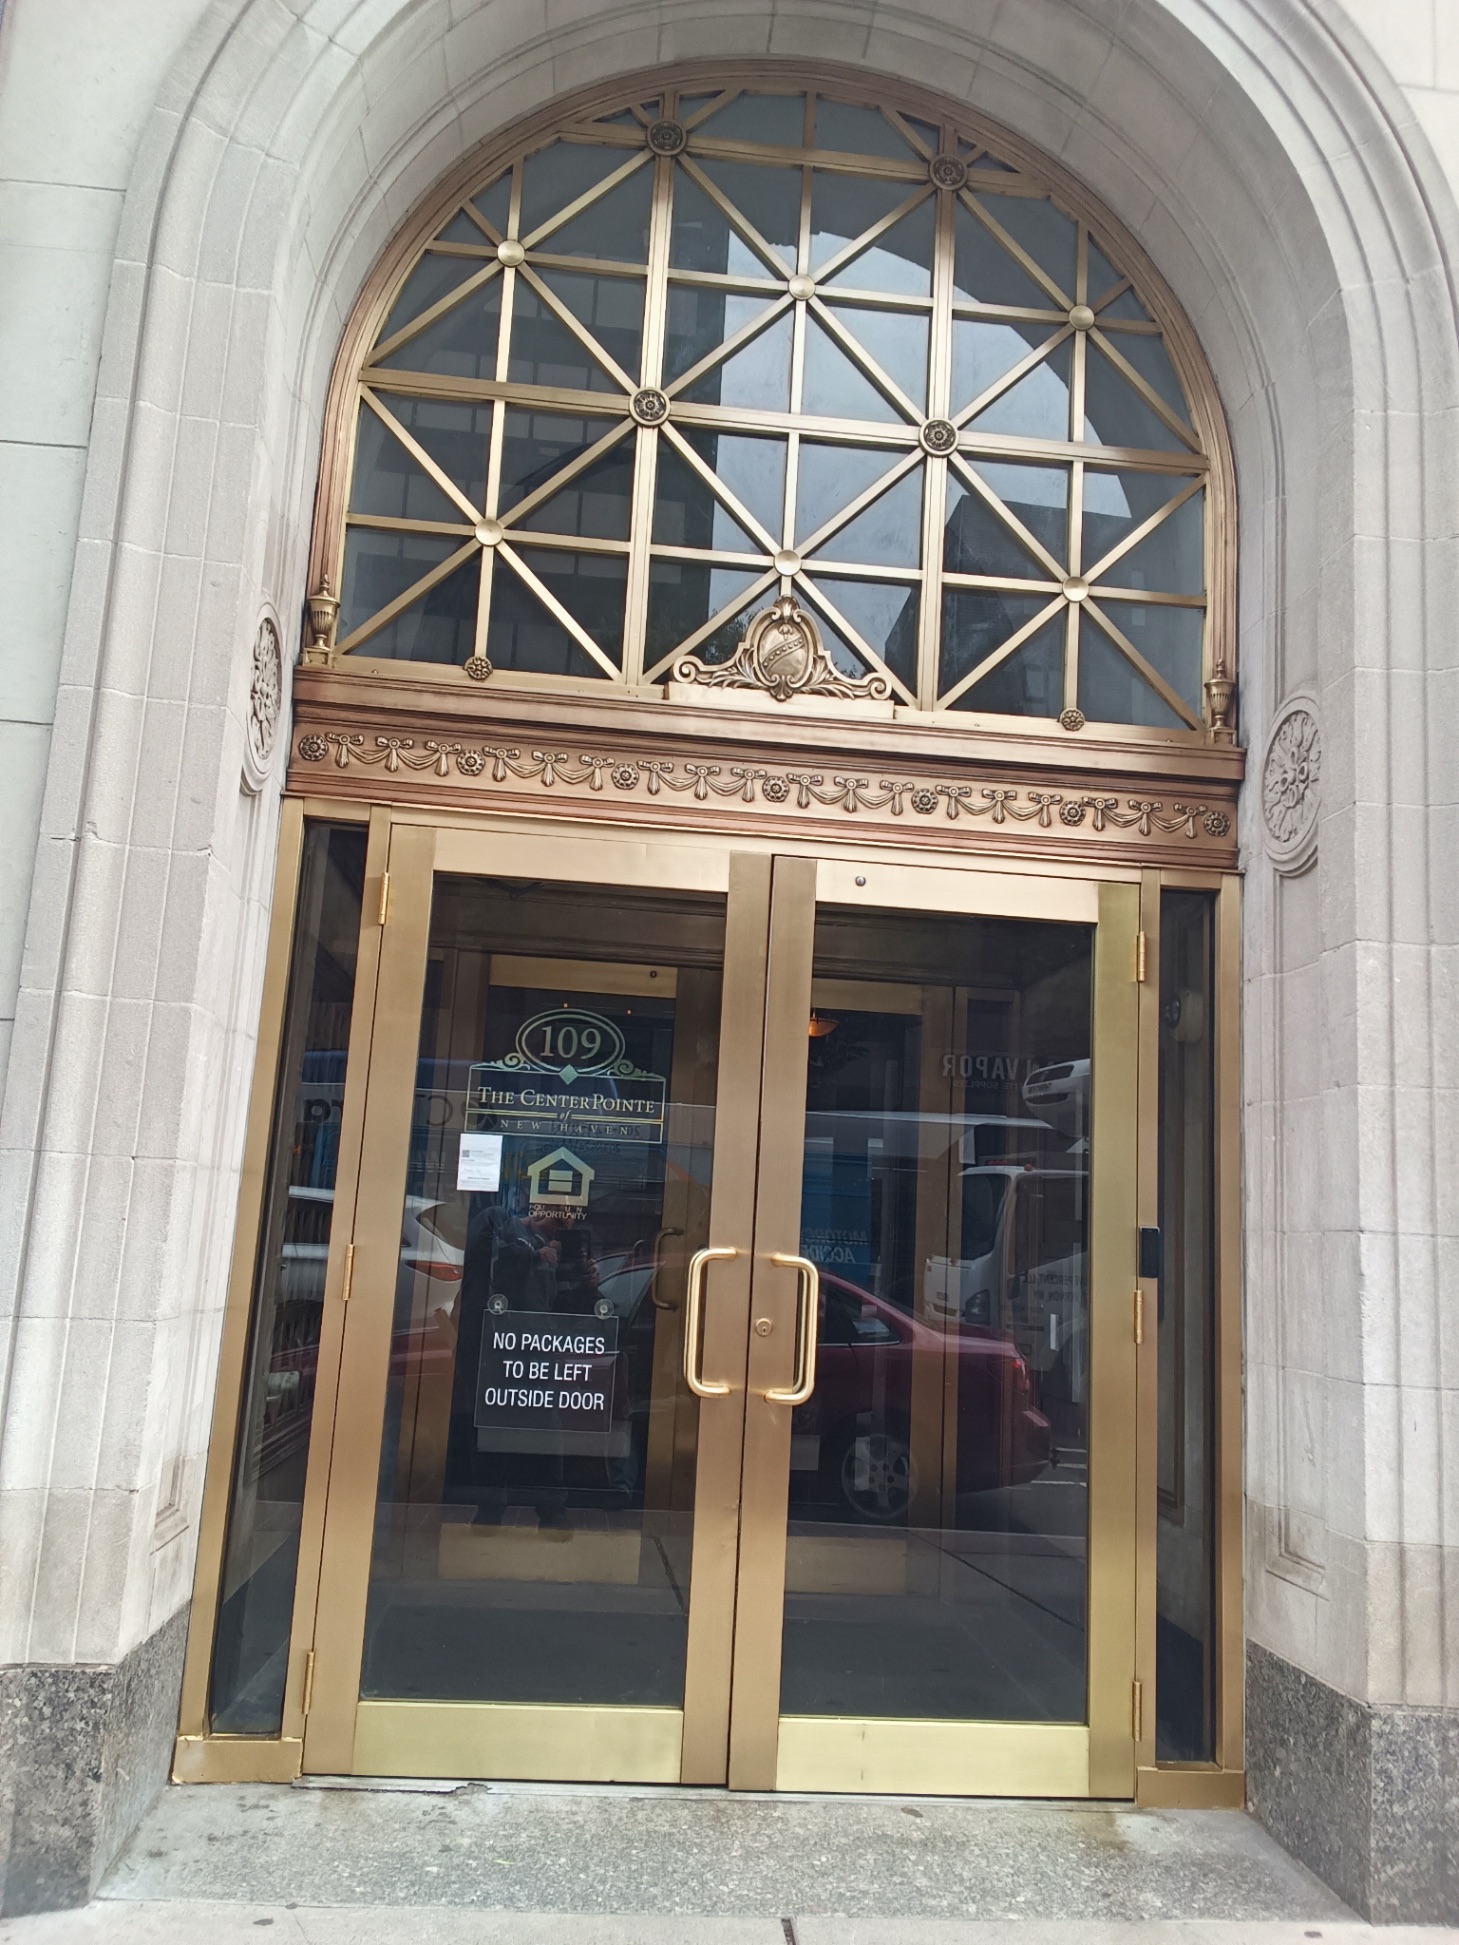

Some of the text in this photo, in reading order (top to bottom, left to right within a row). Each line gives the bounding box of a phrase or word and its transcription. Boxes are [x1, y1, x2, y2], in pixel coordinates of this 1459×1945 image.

[540, 1026, 601, 1060] 109
[477, 1086, 514, 1105] THE
[559, 1110, 571, 1121] of
[500, 1119, 543, 1130] NEW
[560, 1122, 629, 1136] HAVEN
[528, 1210, 587, 1221] OPPORTUNITY
[493, 1332, 605, 1354] NO PACKAGES
[503, 1361, 592, 1381] TO BE LEFT
[485, 1388, 604, 1410] OUTSIDE DOOR
